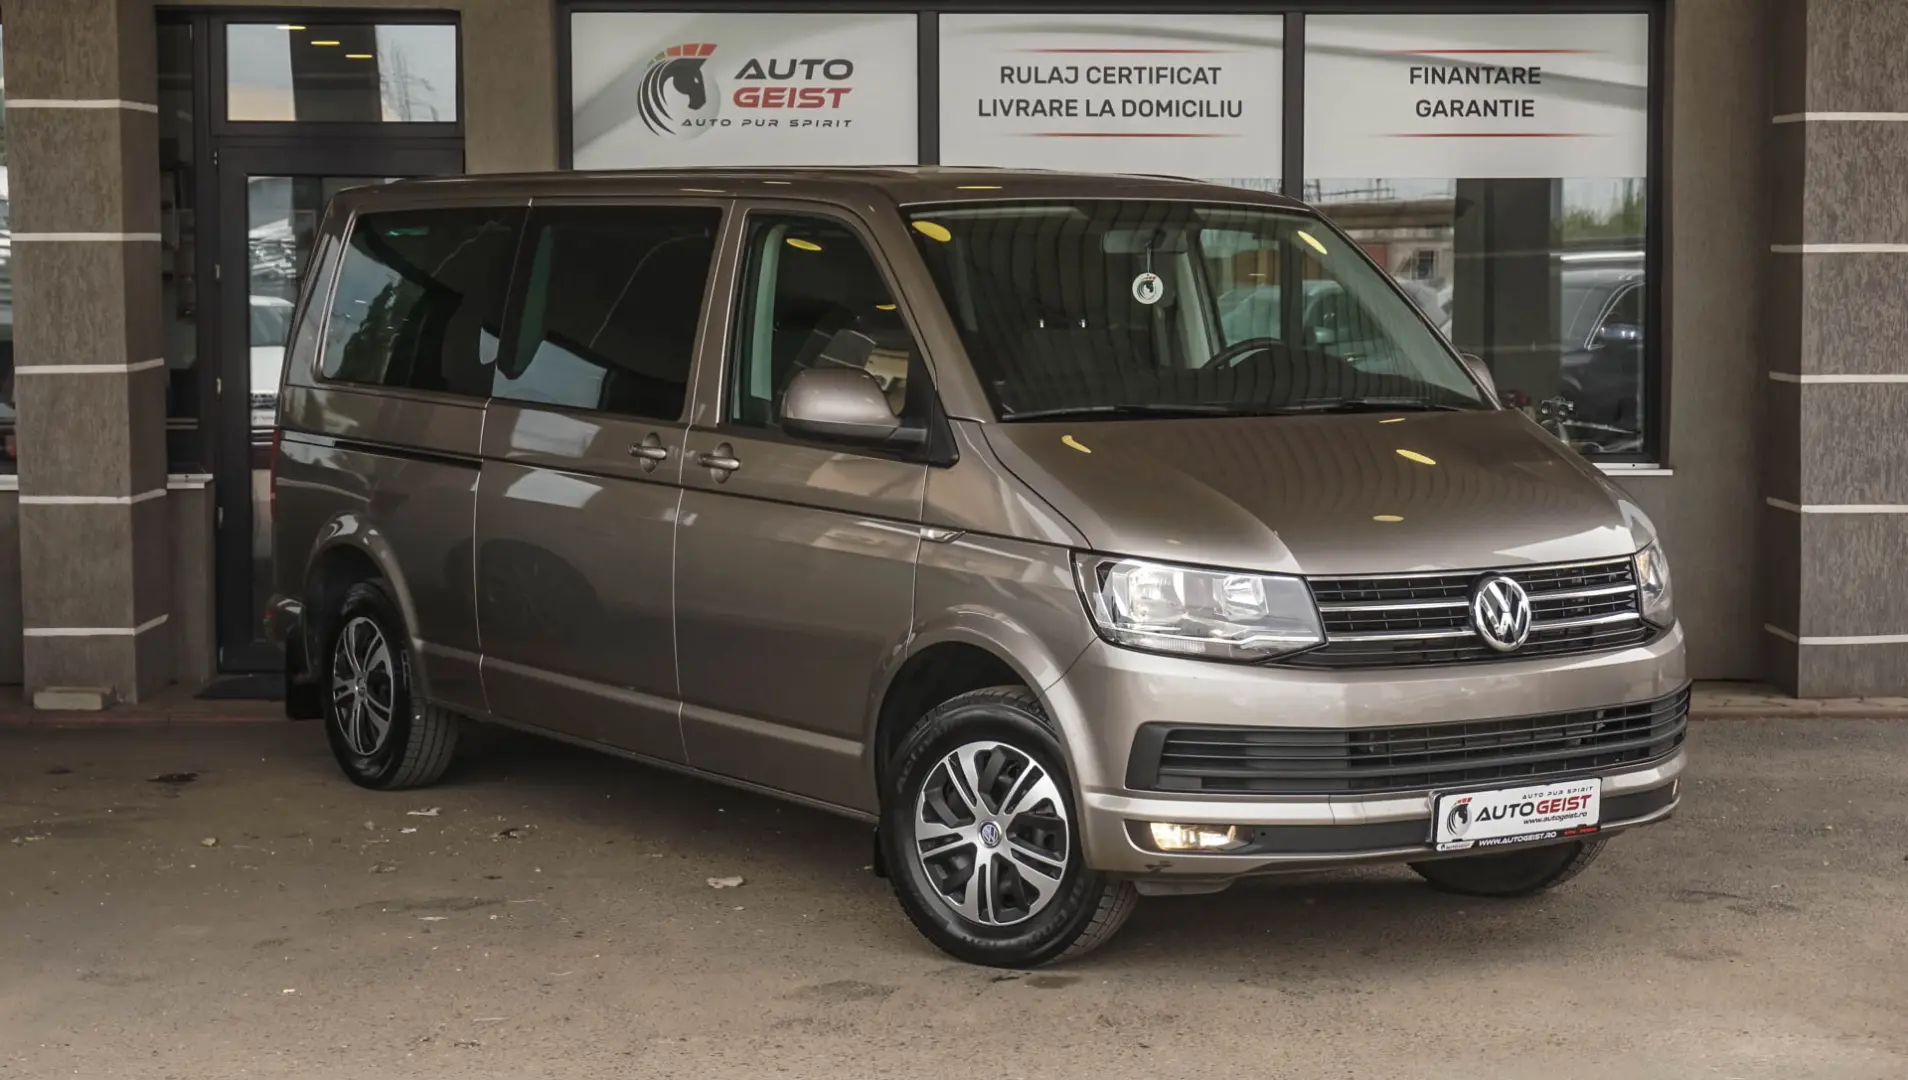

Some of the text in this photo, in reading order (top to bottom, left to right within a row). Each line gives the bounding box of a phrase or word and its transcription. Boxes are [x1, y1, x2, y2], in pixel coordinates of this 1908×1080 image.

[733, 58, 854, 80] AUTO
[1000, 66, 1221, 85] RULAJ CERTIFICAT
[1409, 66, 1541, 85] FINANTARE
[732, 87, 853, 109] GEIST
[978, 99, 1242, 118] LIVRARE LA DOMICILIU
[1415, 99, 1535, 118] GARANTIE
[681, 118, 853, 128] AUTO PUR SPIRIT
[1567, 786, 1594, 794] SPIRIT
[1523, 811, 1588, 825] www.autogeist.ro
[1479, 831, 1557, 847] WWW.AUTOGEIST.RO
